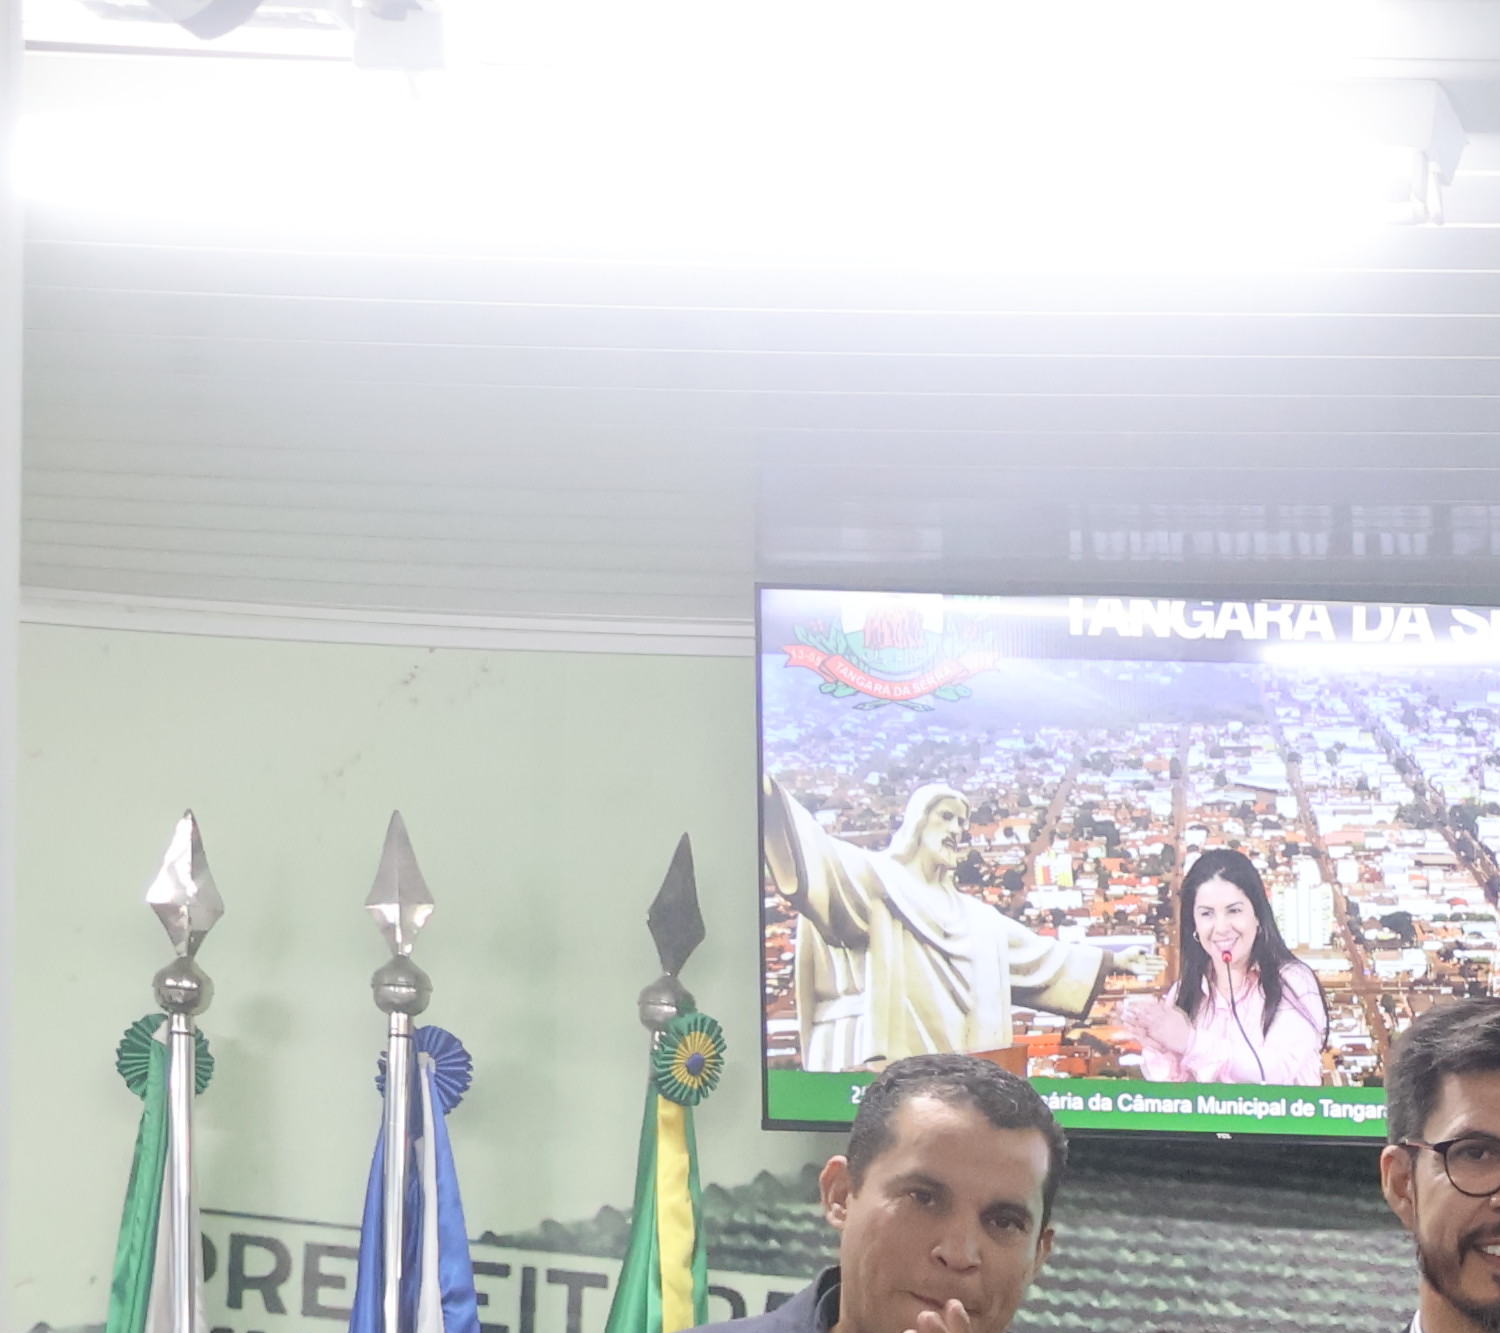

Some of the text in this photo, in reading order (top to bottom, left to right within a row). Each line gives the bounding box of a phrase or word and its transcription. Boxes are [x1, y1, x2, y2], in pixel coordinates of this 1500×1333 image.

[1040, 1092, 1389, 1123] ária da Câmara Municipal de Tangar
